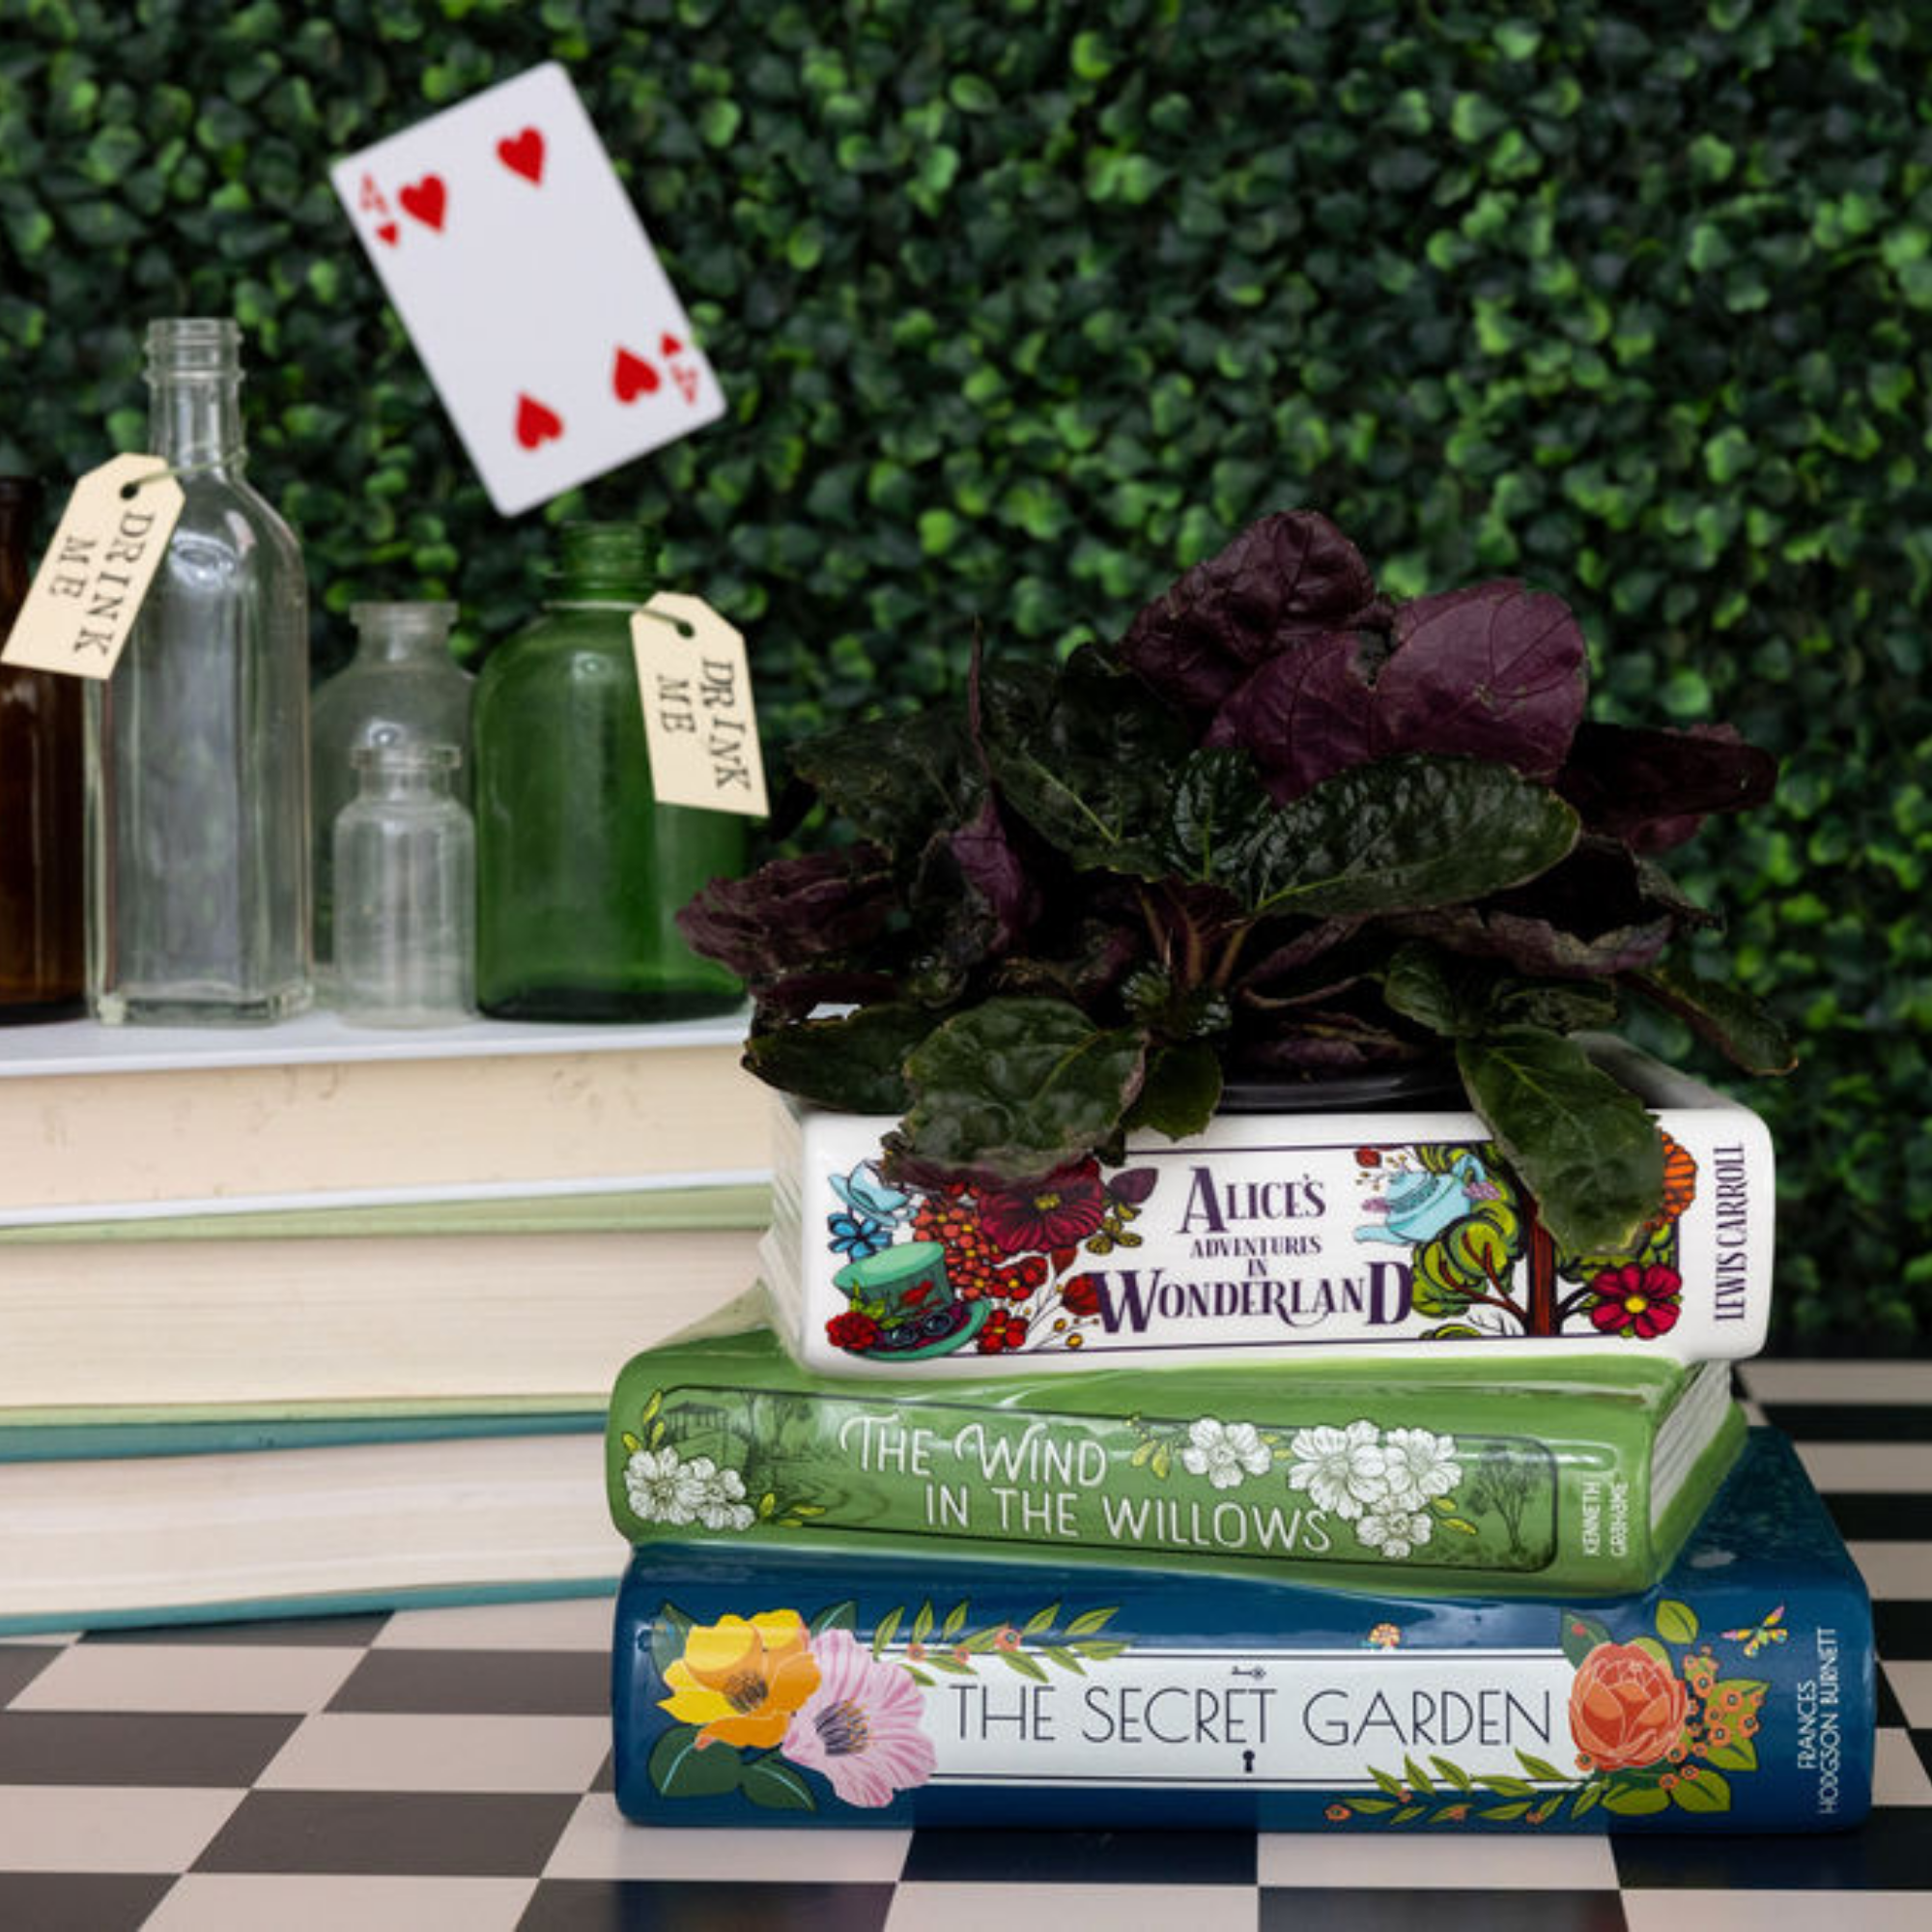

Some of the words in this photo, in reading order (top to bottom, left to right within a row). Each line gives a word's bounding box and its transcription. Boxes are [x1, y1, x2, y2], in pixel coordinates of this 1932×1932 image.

[49, 535, 98, 598] ME
[74, 511, 155, 656] DRINK
[658, 674, 696, 732] ME
[700, 658, 752, 791] DRINK
[1176, 1165, 1326, 1234] ALICE'S
[1713, 1143, 1748, 1247] CARROLL
[1189, 1236, 1322, 1259] ADVENTURES
[1247, 1258, 1268, 1278] IN
[1086, 1261, 1414, 1333] WONDERLAND
[1714, 1252, 1747, 1321] LEWIS
[838, 1413, 934, 1476] THE
[953, 1422, 1107, 1489] WIND
[925, 1484, 969, 1527] IN
[991, 1487, 1079, 1538] THE
[1102, 1495, 1332, 1553] WILLOWS
[1582, 1481, 1601, 1557] KENNETH
[1817, 1627, 1839, 1705] BURNETT
[949, 1684, 1057, 1743] THE
[1081, 1686, 1277, 1744] SECRET
[1301, 1689, 1551, 1747] GARDEN
[1797, 1679, 1818, 1770] FRANCES
[1819, 1712, 1840, 1814] HODGSON
